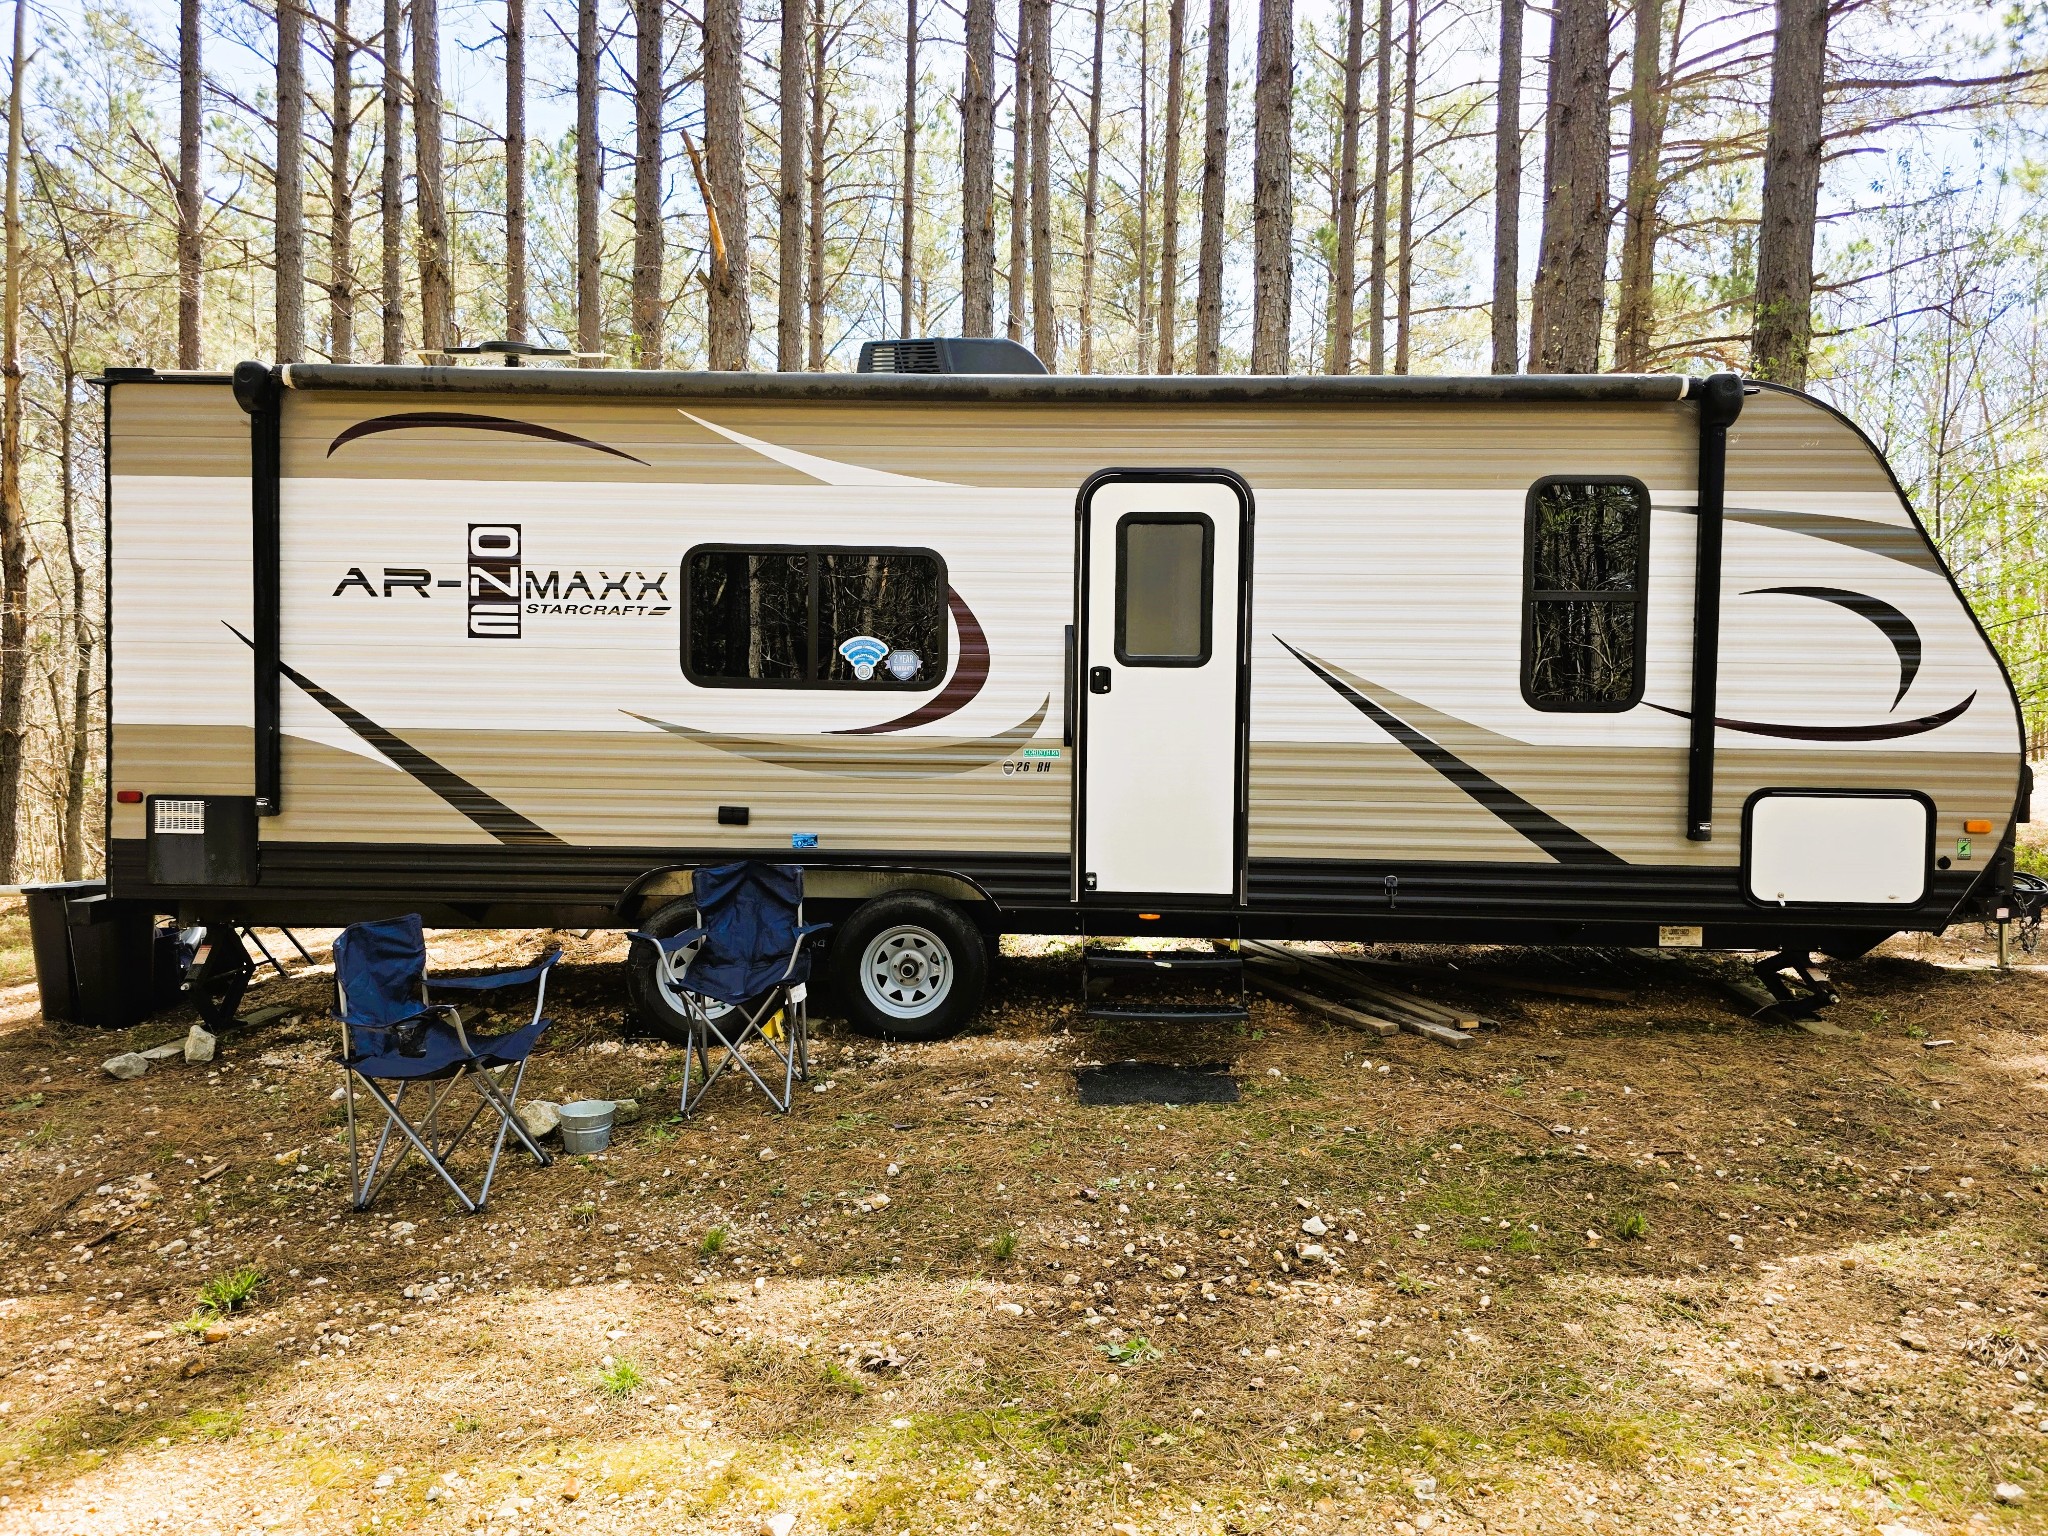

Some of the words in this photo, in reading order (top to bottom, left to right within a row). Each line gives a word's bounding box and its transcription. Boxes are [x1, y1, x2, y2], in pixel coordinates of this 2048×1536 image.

[525, 570, 669, 601] MAXX
[525, 603, 649, 616] STARCRAFT
[894, 654, 898, 663] 2
[899, 654, 914, 663] YEAR
[1016, 762, 1030, 772] 26
[1037, 762, 1051, 772] BH
